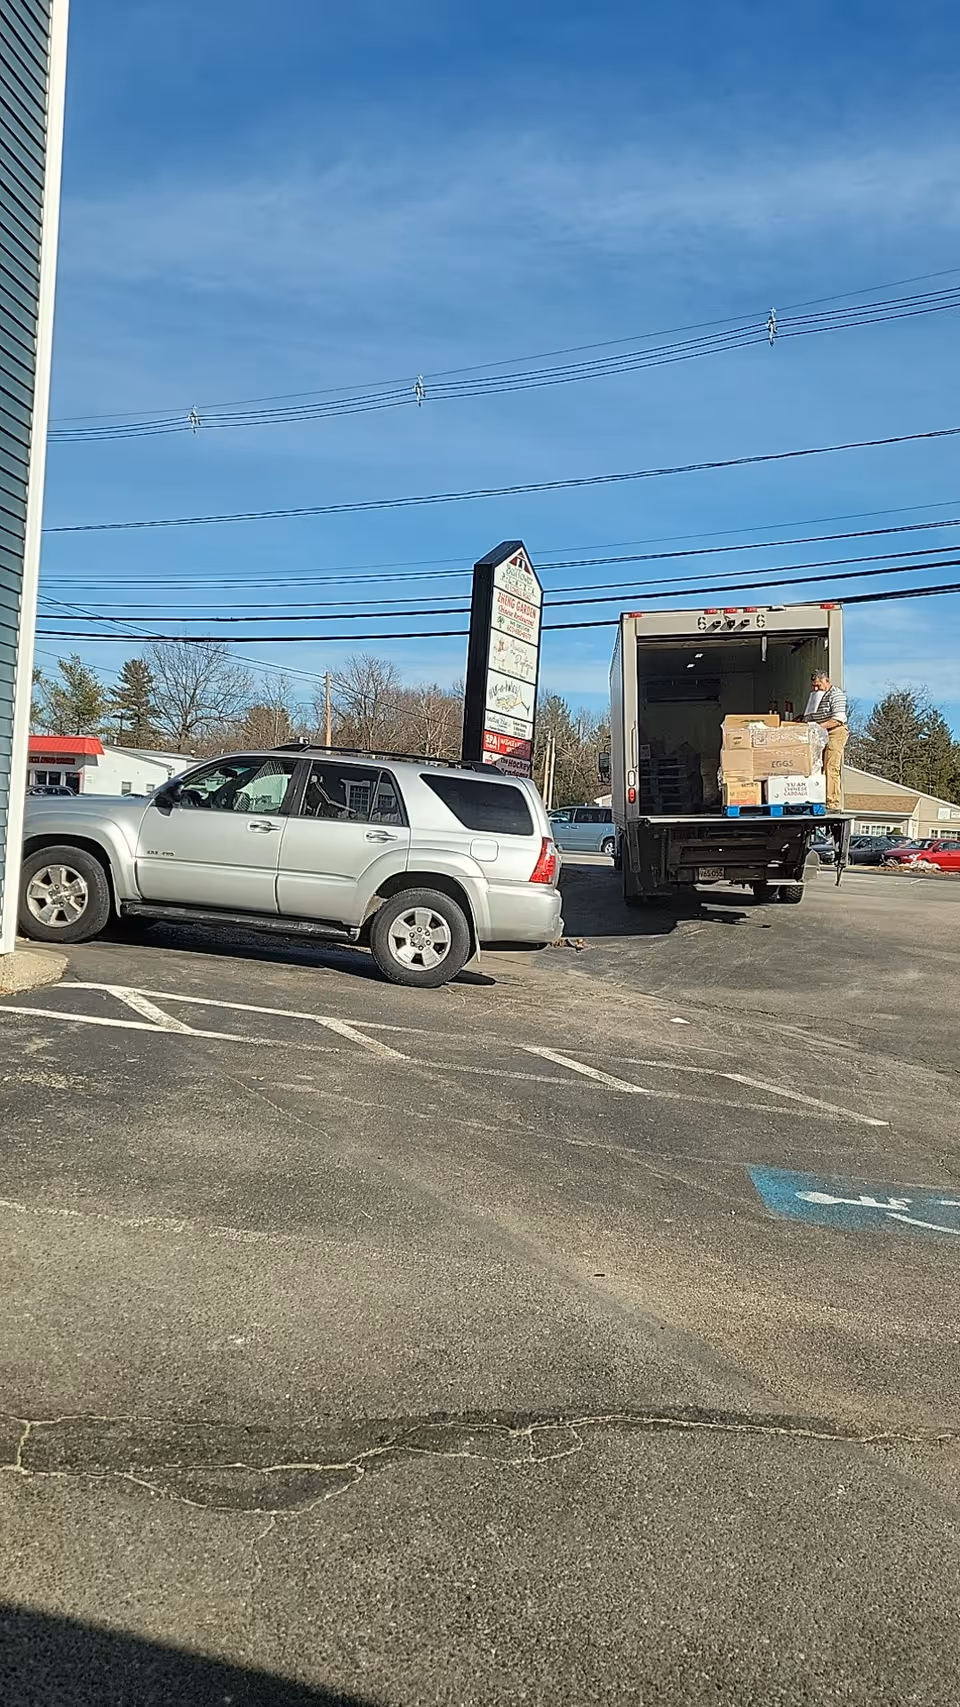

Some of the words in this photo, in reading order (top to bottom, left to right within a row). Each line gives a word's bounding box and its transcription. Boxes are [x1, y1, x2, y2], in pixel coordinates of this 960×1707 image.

[497, 591, 516, 609] ZHENG
[515, 601, 537, 619] GARDEN
[498, 604, 514, 617] Chinese
[513, 612, 535, 627] Restaurant
[485, 733, 498, 746] SPA
[507, 758, 530, 773] Hockey
[771, 760, 794, 768] EGGS
